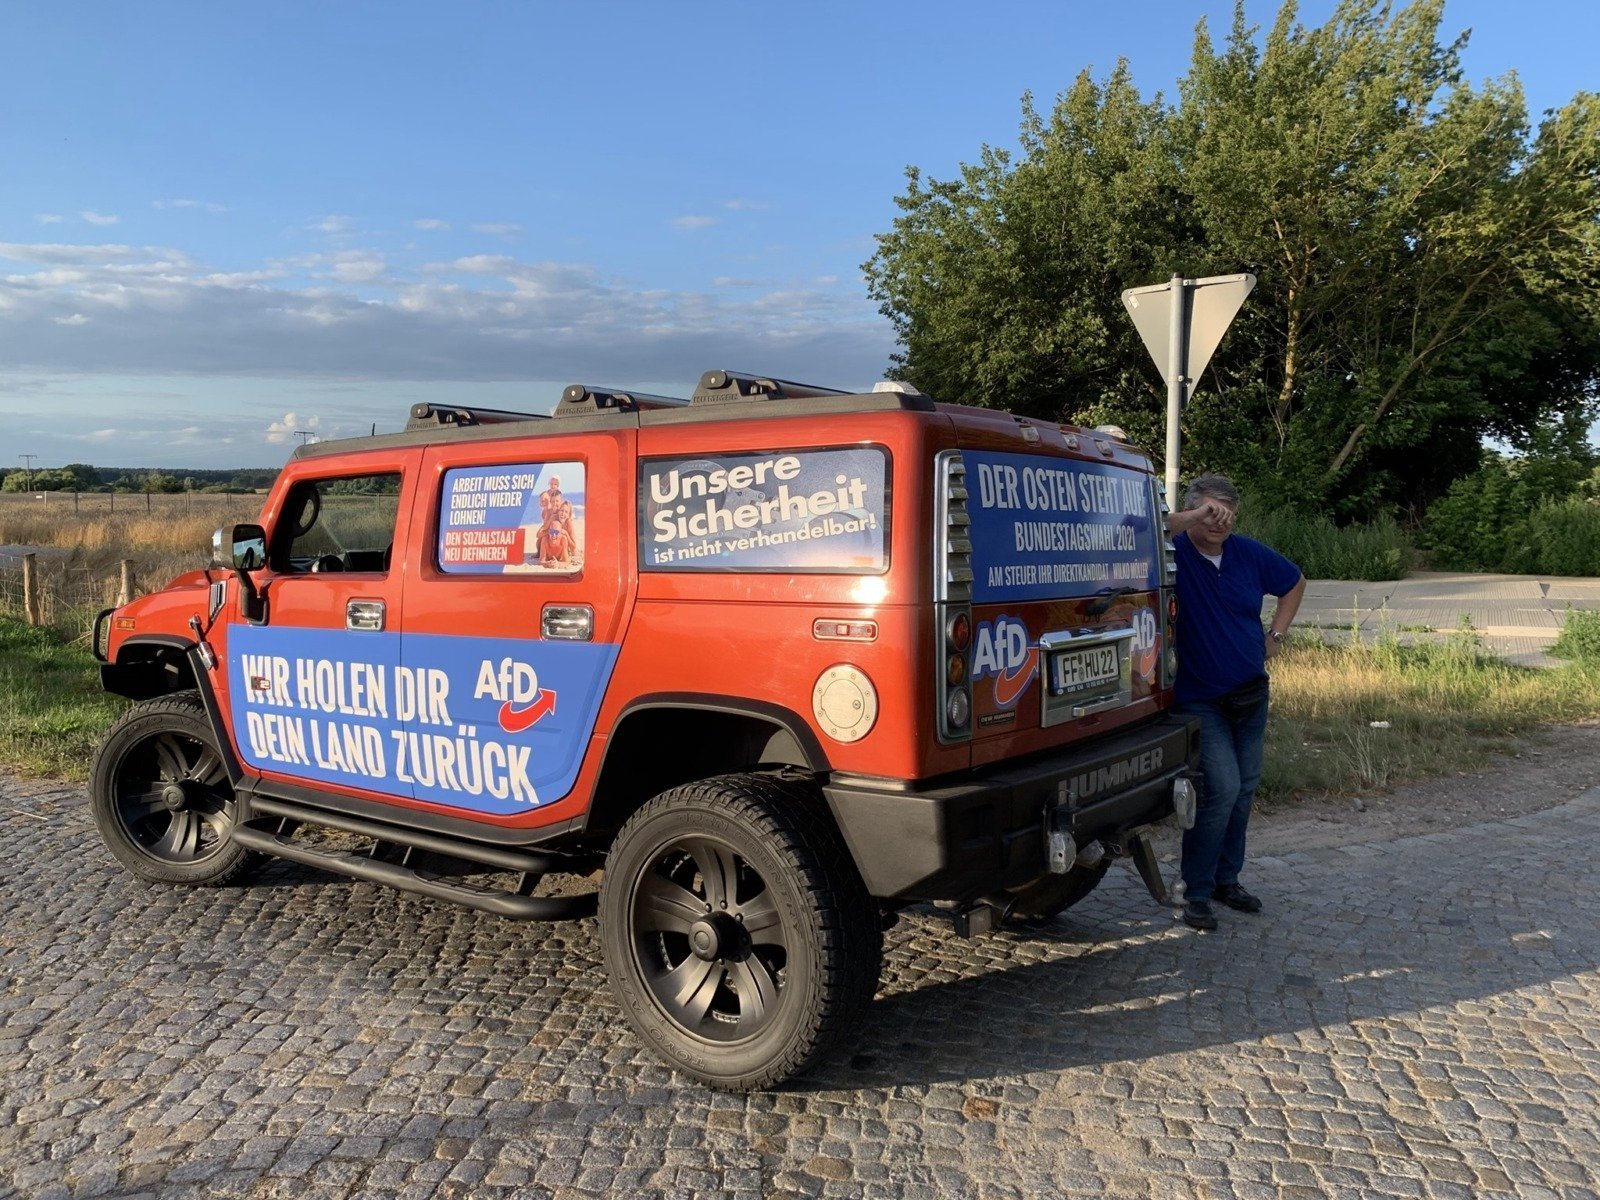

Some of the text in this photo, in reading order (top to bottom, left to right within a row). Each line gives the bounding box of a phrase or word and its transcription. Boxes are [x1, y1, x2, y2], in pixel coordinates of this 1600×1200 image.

[451, 492, 523, 509] ENDLICH WIEDER
[452, 474, 535, 492] ARBEIT MUSS SICH
[650, 456, 801, 504] Unsere
[978, 463, 1021, 509] DER
[1023, 467, 1078, 512] OSTEN
[1078, 472, 1121, 514] STEHT
[449, 510, 486, 526] LOHNEN!
[653, 474, 868, 543] Sicherheit
[444, 546, 508, 561] NEU DEFINIEREN
[445, 530, 517, 546] DEN SOZIALSTAAT
[654, 513, 877, 564] ist nicht verhandelbar!
[1014, 522, 1136, 552] BUNDESTAGSWAHL 2021
[988, 567, 1003, 587] AM
[1004, 565, 1037, 585] STEUER
[1038, 564, 1052, 584] IHR
[1053, 563, 1109, 582] DIREKTKANDIDAT
[972, 620, 1027, 675] AfD
[1131, 610, 1156, 651] AfD
[242, 654, 453, 726] WIR HOLEN DIR
[473, 657, 538, 703] AfD
[1063, 655, 1077, 684] FF
[247, 712, 540, 804] DEIN LAND ZURÜCK
[1058, 746, 1164, 806] HUMMER
[650, 1028, 706, 1071] TOYO
